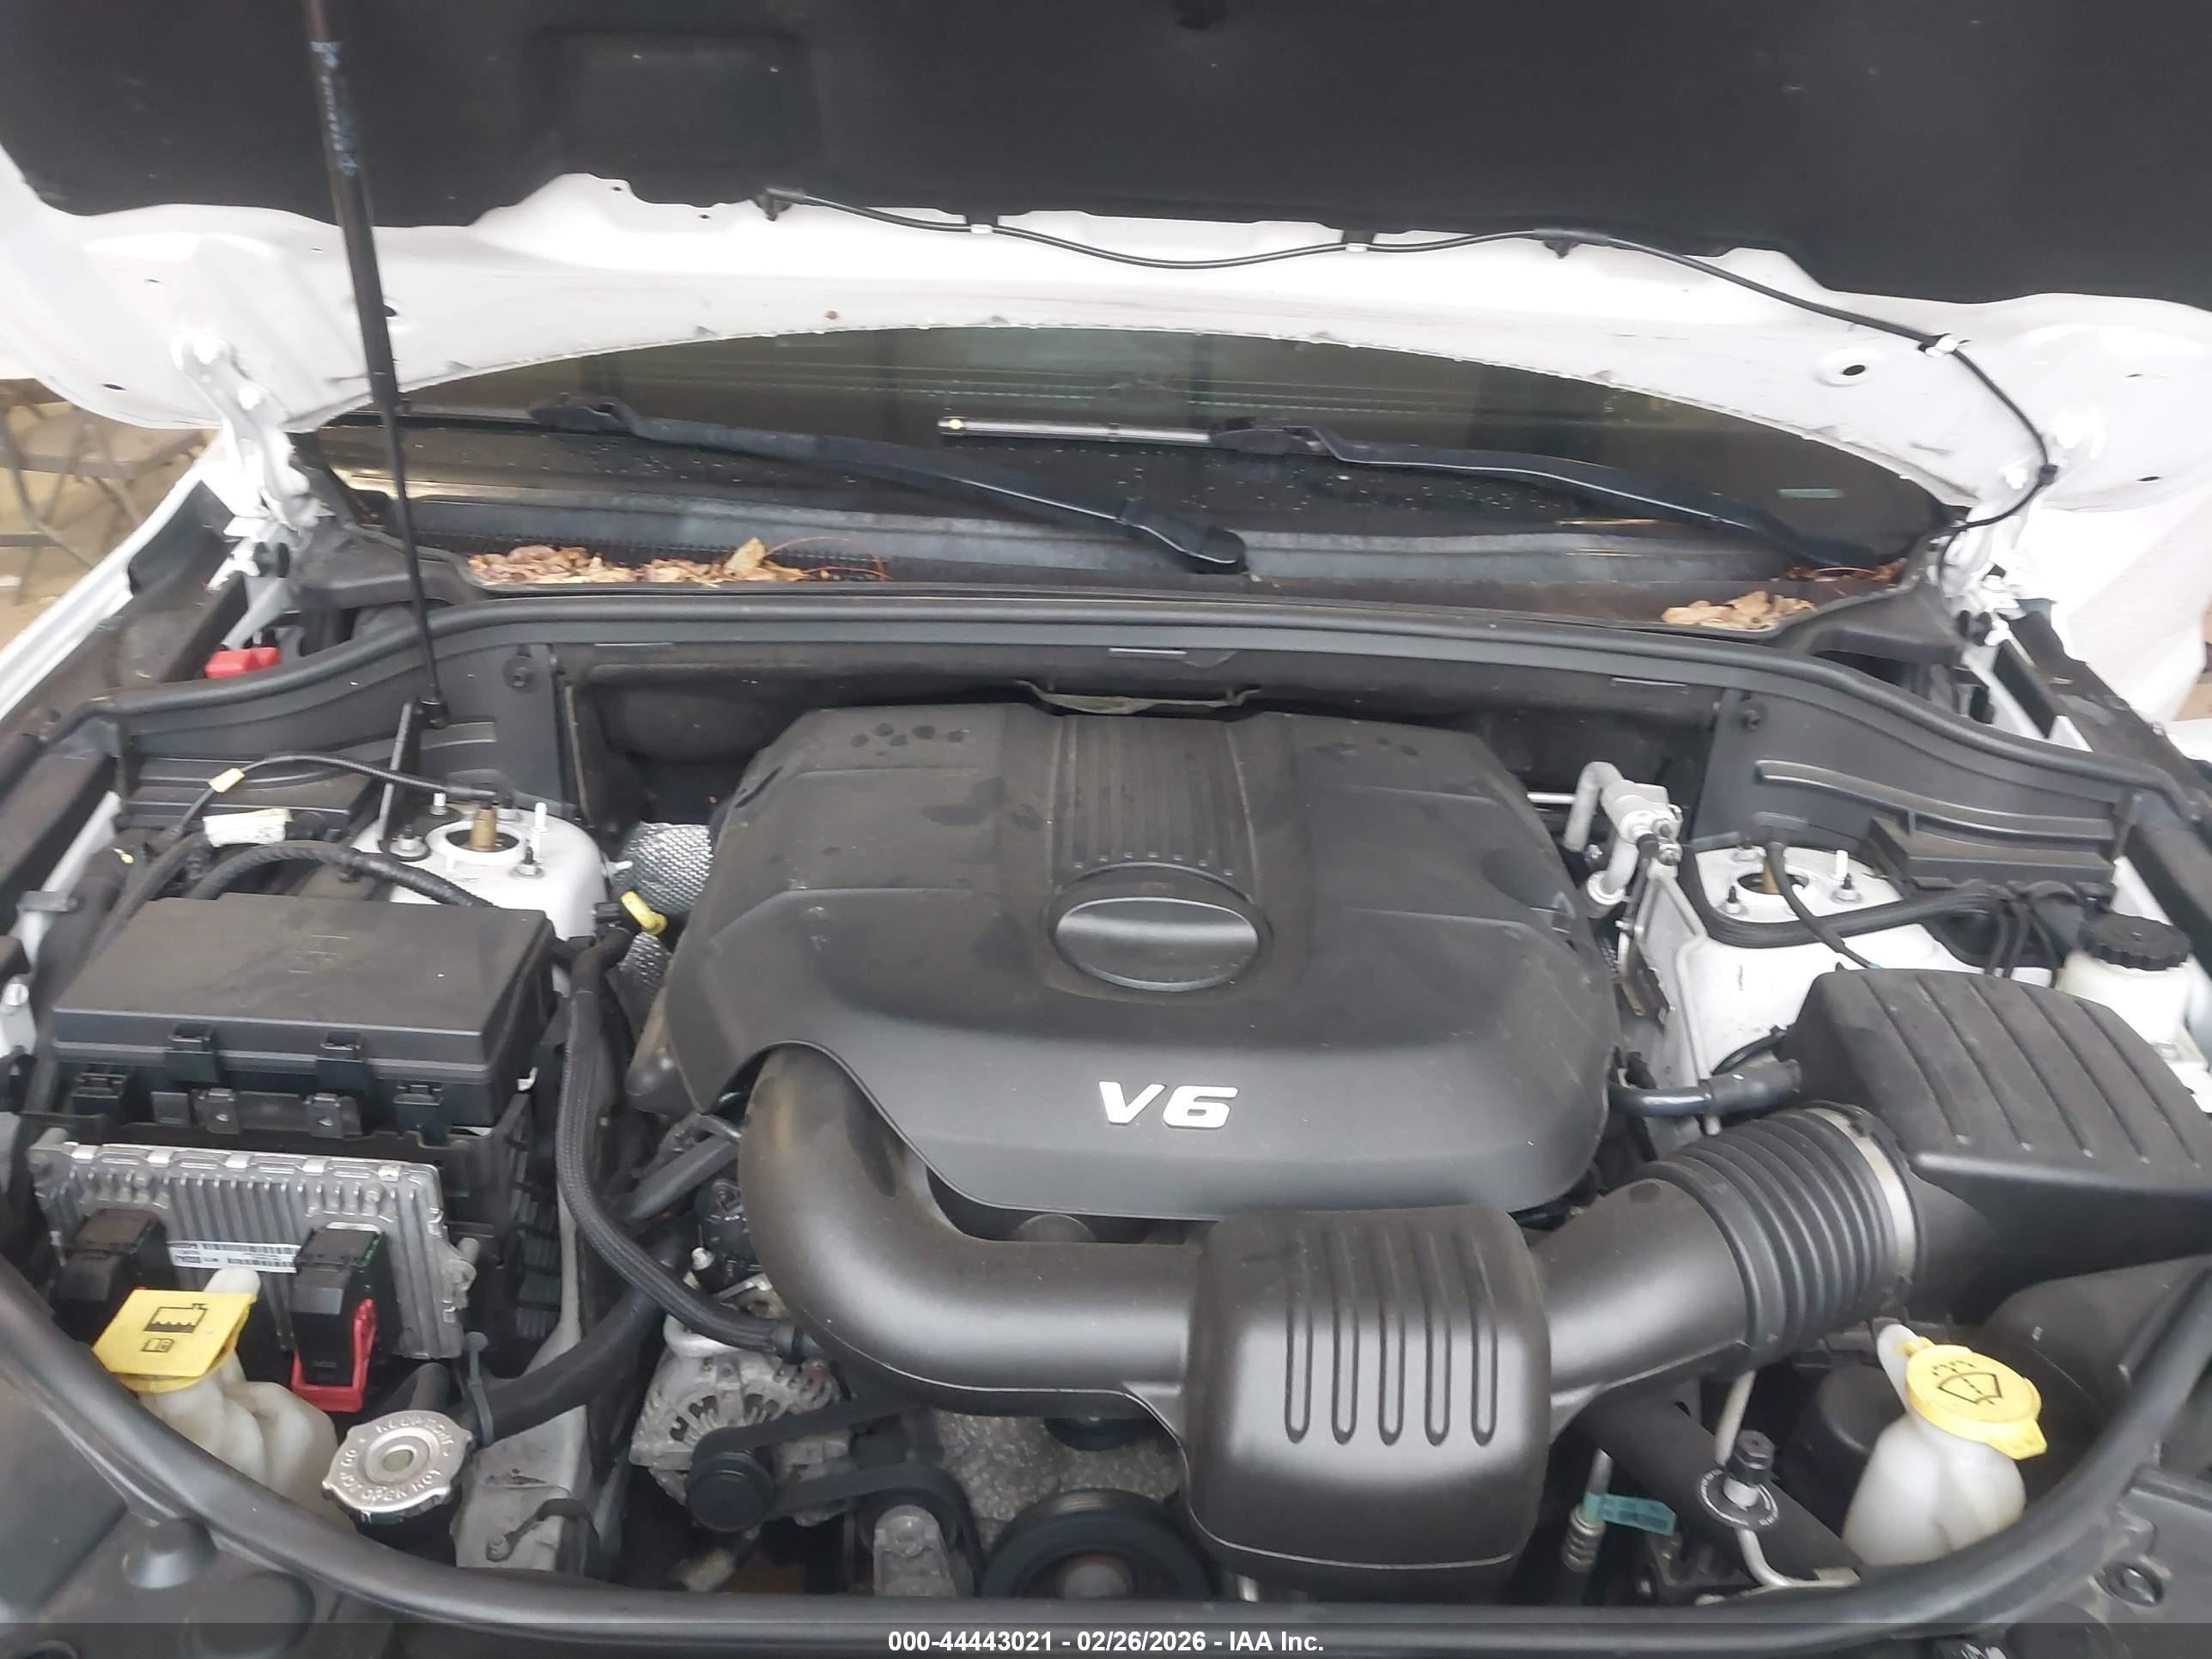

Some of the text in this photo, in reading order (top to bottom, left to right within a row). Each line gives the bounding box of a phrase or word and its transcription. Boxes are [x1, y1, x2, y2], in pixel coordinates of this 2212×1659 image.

[1098, 1080, 1240, 1130] V6
[361, 1486, 408, 1502] OPEN
[411, 1469, 441, 1492] HOT
